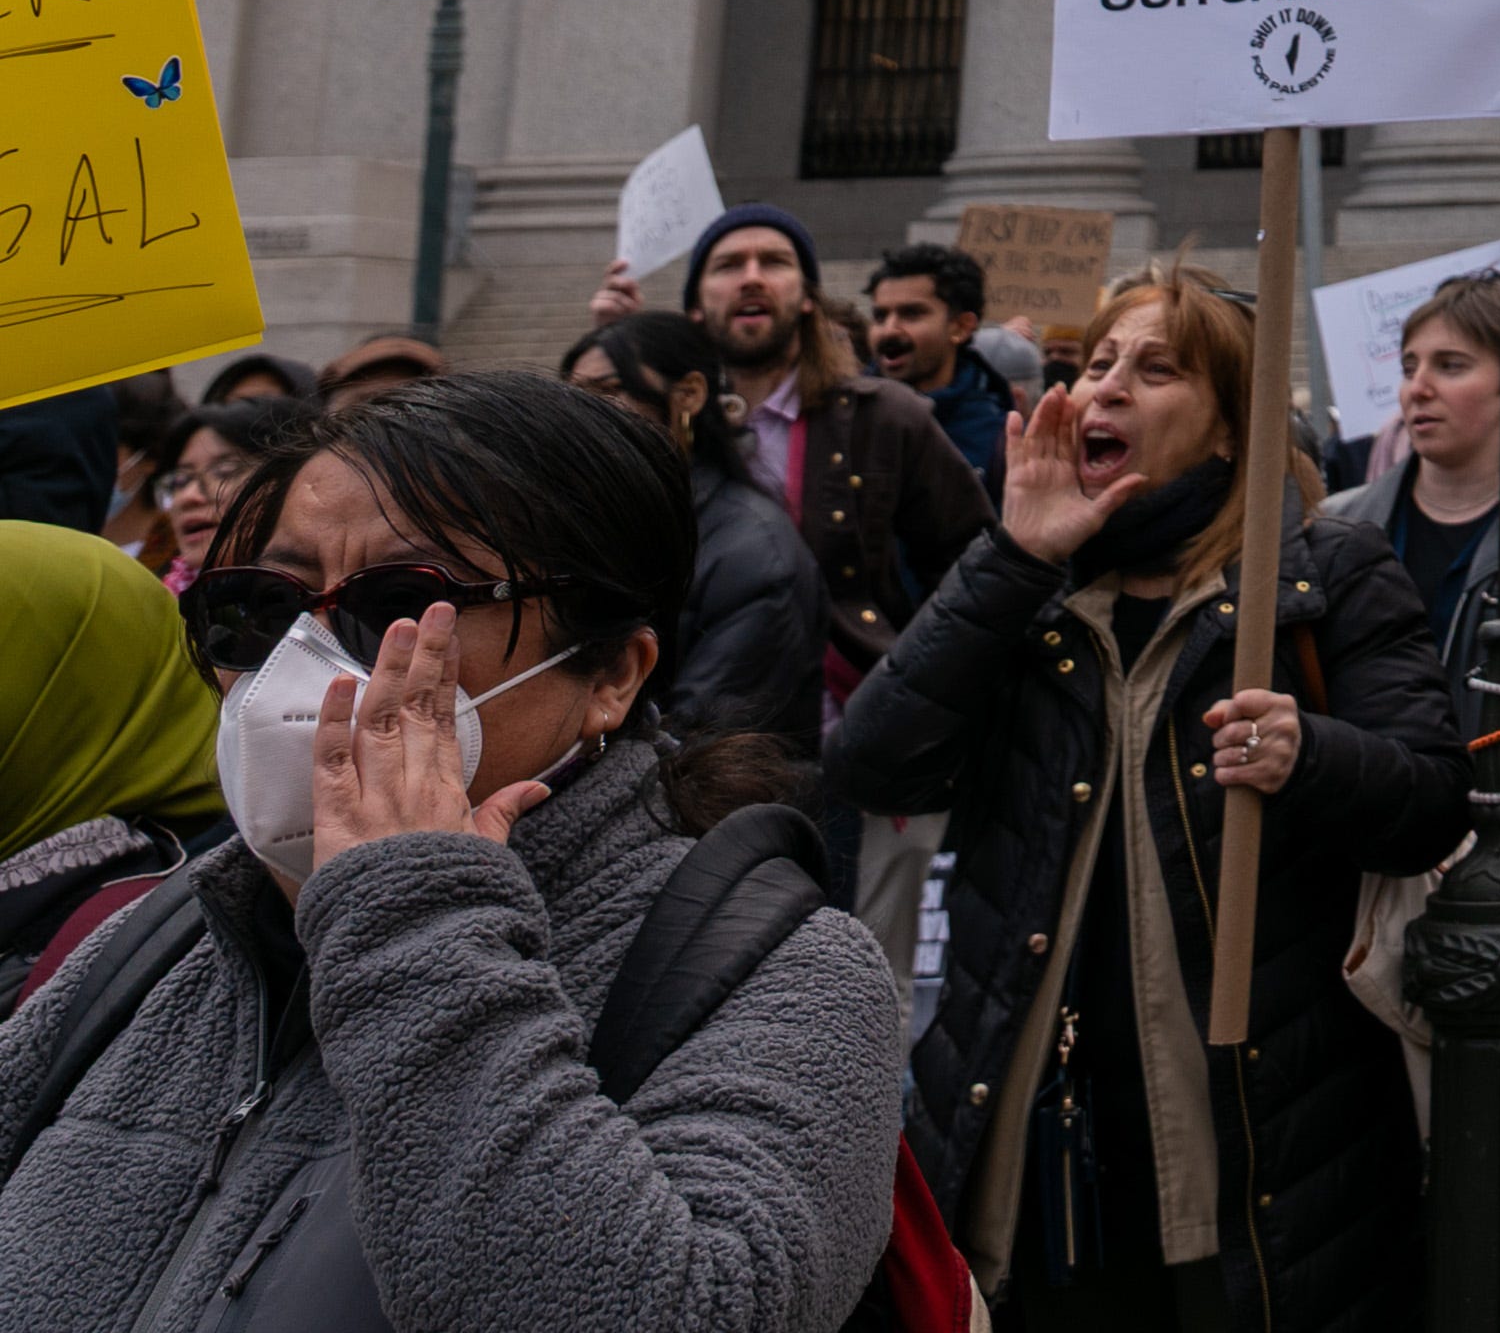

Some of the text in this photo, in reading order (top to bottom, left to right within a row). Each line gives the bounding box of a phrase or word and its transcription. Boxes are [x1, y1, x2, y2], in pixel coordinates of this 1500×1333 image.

[1250, 7, 1337, 49] SHUT IT DOWN!
[1252, 48, 1336, 94] FOR PALESTINE
